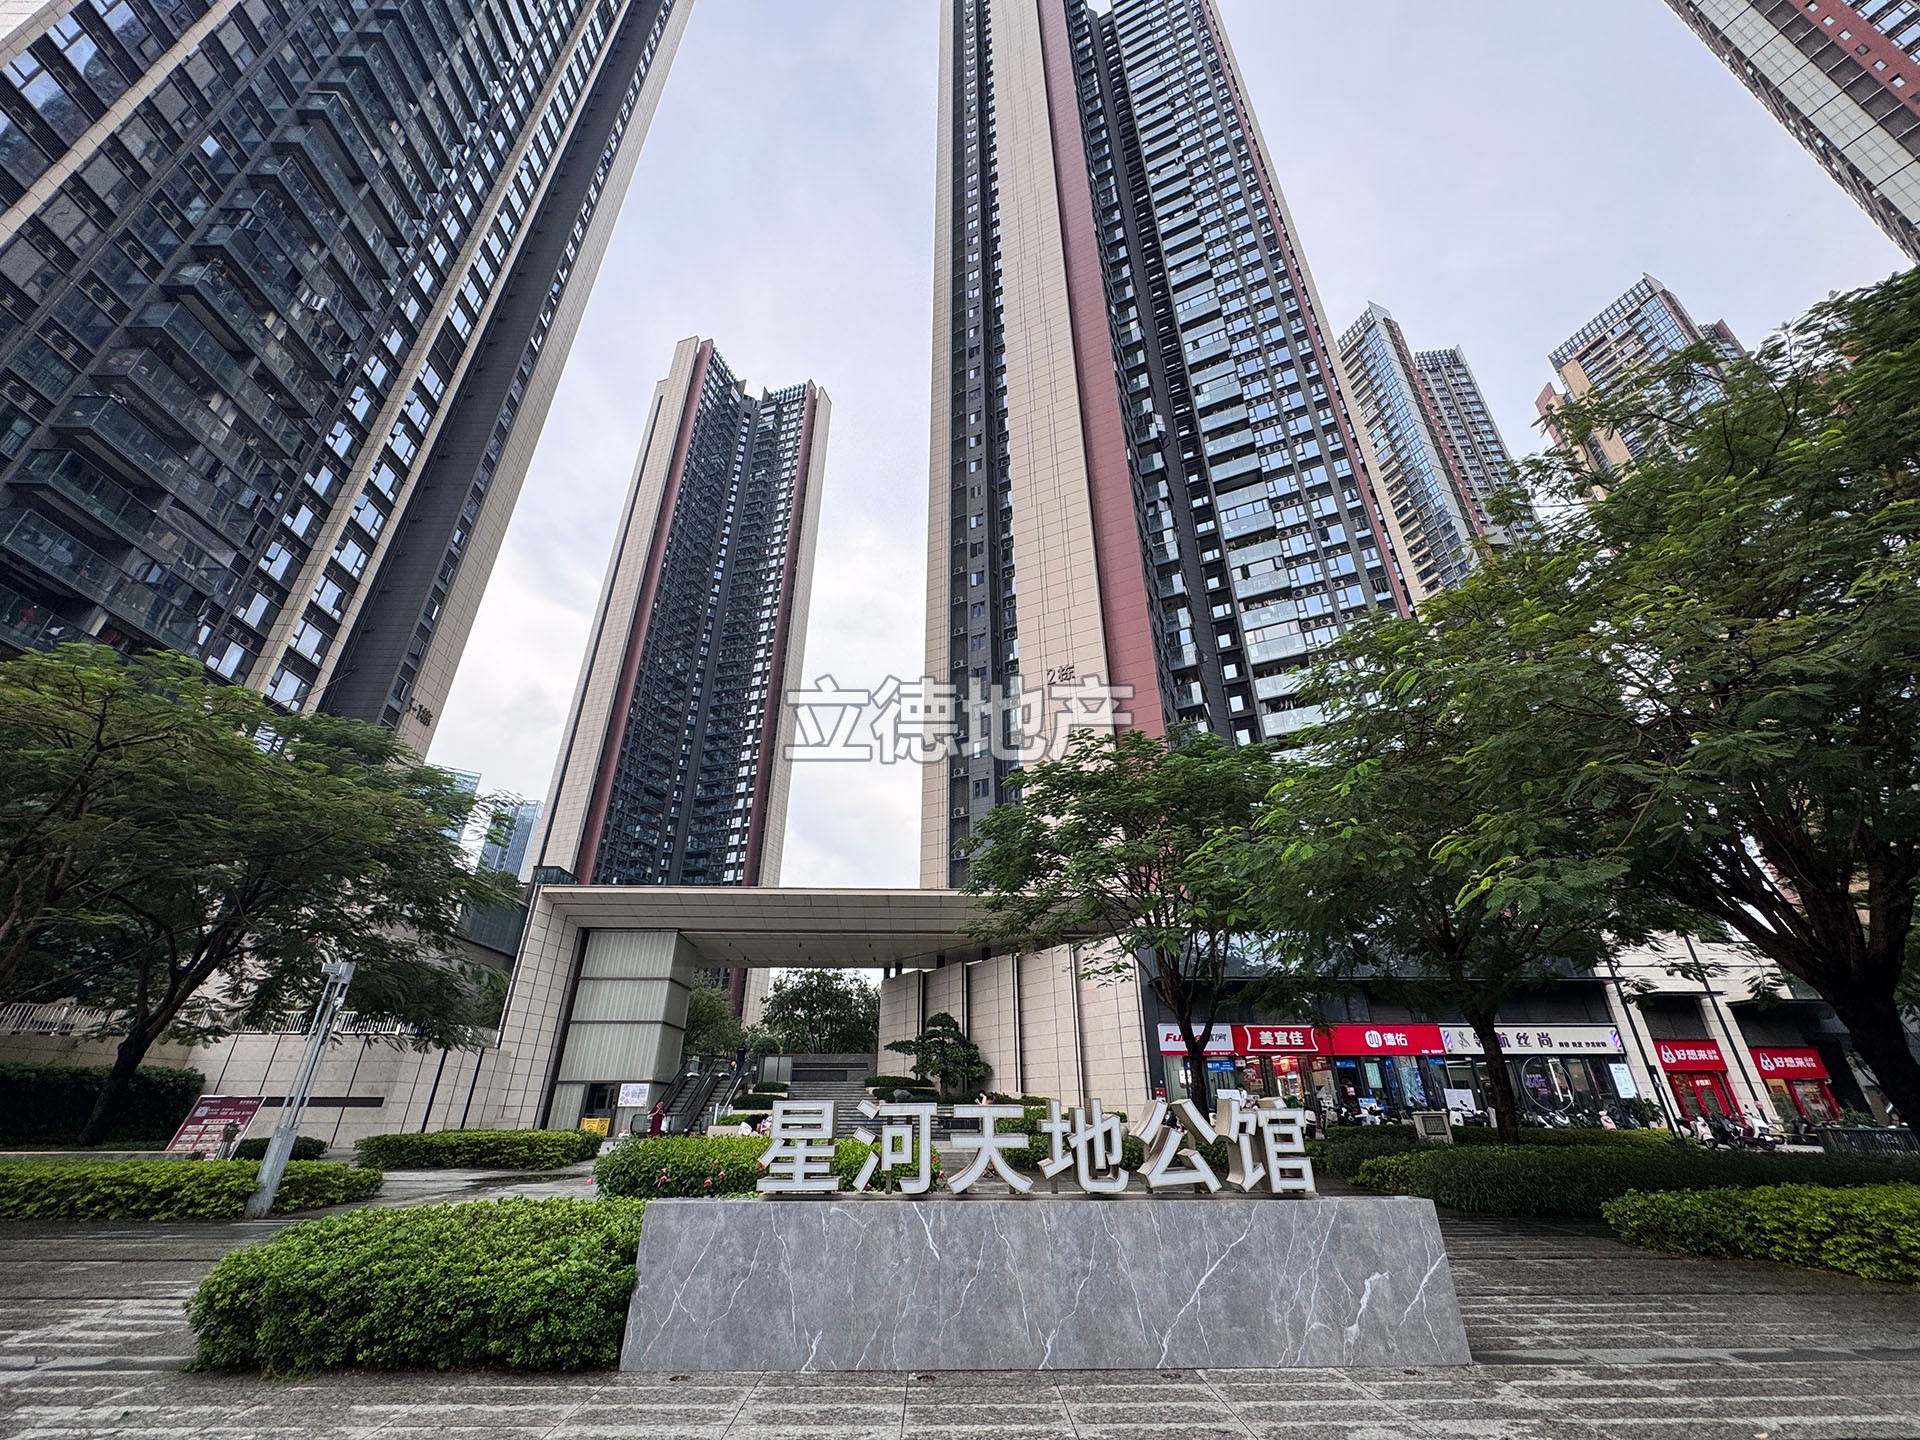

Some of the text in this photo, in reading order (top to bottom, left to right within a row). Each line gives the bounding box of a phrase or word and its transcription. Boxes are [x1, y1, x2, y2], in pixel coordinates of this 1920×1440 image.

[1047, 664, 1075, 686] 2栋
[1259, 1031, 1304, 1046] 美宜佳
[1382, 1032, 1408, 1046] 德佑
[1674, 1049, 1709, 1061] 好想来
[756, 1097, 1317, 1194] 星河天地公馆
